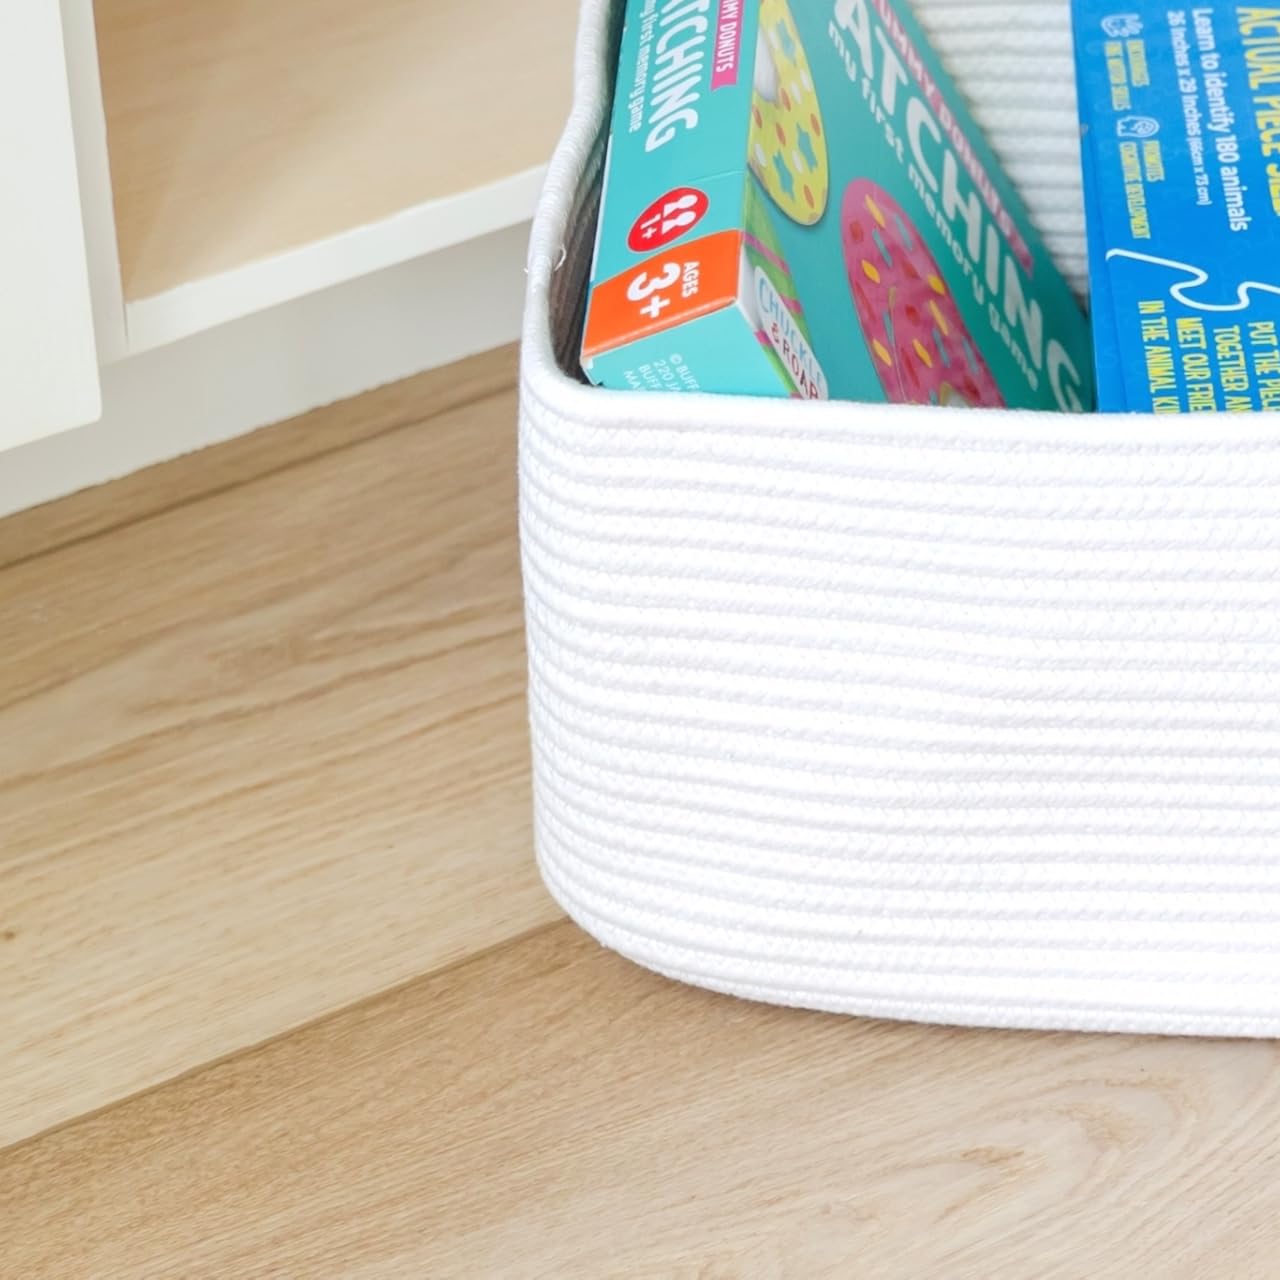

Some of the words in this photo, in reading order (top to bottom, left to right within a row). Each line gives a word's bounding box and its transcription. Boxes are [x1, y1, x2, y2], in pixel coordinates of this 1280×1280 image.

[716, 21, 738, 73] DONUTS
[1191, 7, 1216, 51] Learn
[629, 43, 651, 99] memory
[1200, 52, 1221, 71] to
[627, 95, 645, 134] game
[1203, 71, 1235, 133] identify
[1215, 134, 1241, 163] 180
[828, 19, 856, 82] my
[861, 76, 904, 164] first
[908, 163, 985, 306] memory
[988, 302, 1039, 393] game
[1220, 165, 1253, 232] animals
[640, 214, 662, 240] 1+
[626, 262, 682, 318] 3+
[681, 261, 700, 298] AGES
[1138, 300, 1165, 314] IN
[1141, 316, 1170, 342] THE
[1176, 317, 1207, 349] MEET
[1248, 321, 1278, 346] PUT
[653, 359, 675, 381] 220
[1144, 345, 1177, 393] ANIMAL
[1182, 353, 1212, 380] OUR
[1213, 325, 1249, 392] TOGETHER
